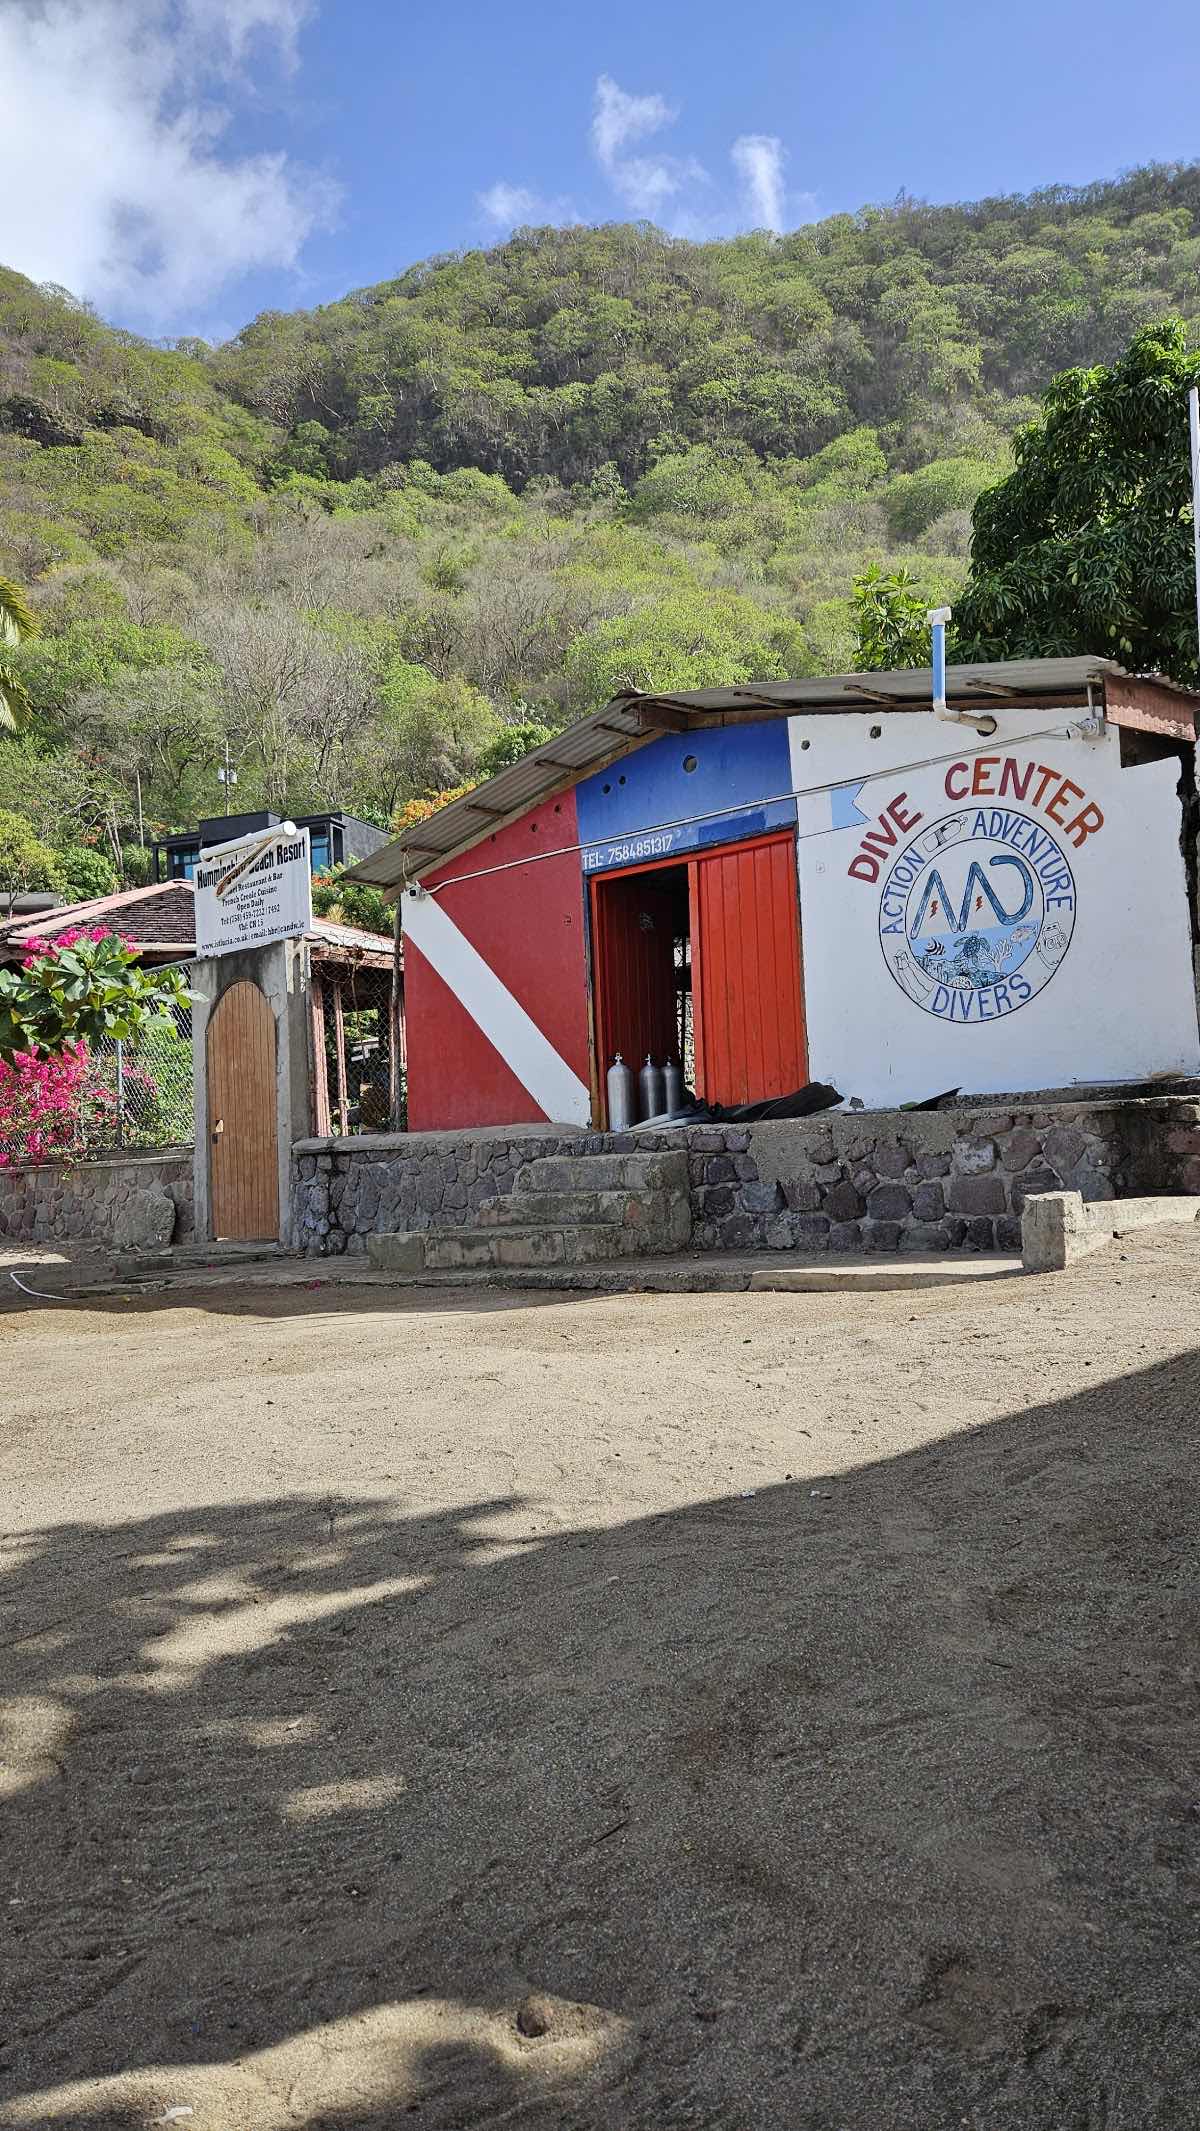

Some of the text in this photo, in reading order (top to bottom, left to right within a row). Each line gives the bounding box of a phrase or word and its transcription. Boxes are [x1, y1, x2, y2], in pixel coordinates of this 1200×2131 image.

[847, 757, 1105, 883] DIVE CENTER
[277, 837, 306, 866] Resort
[607, 834, 674, 864] 7584851317
[971, 810, 1073, 913] ADVENTURE
[222, 895, 240, 907] French
[240, 890, 257, 902] Creole
[257, 886, 278, 897] Cuisine
[237, 876, 267, 892] Restaurant
[272, 872, 283, 881] Bar
[881, 847, 926, 934] ACTION
[236, 897, 264, 913] Open Daily
[931, 973, 1032, 1020] DIVERS
